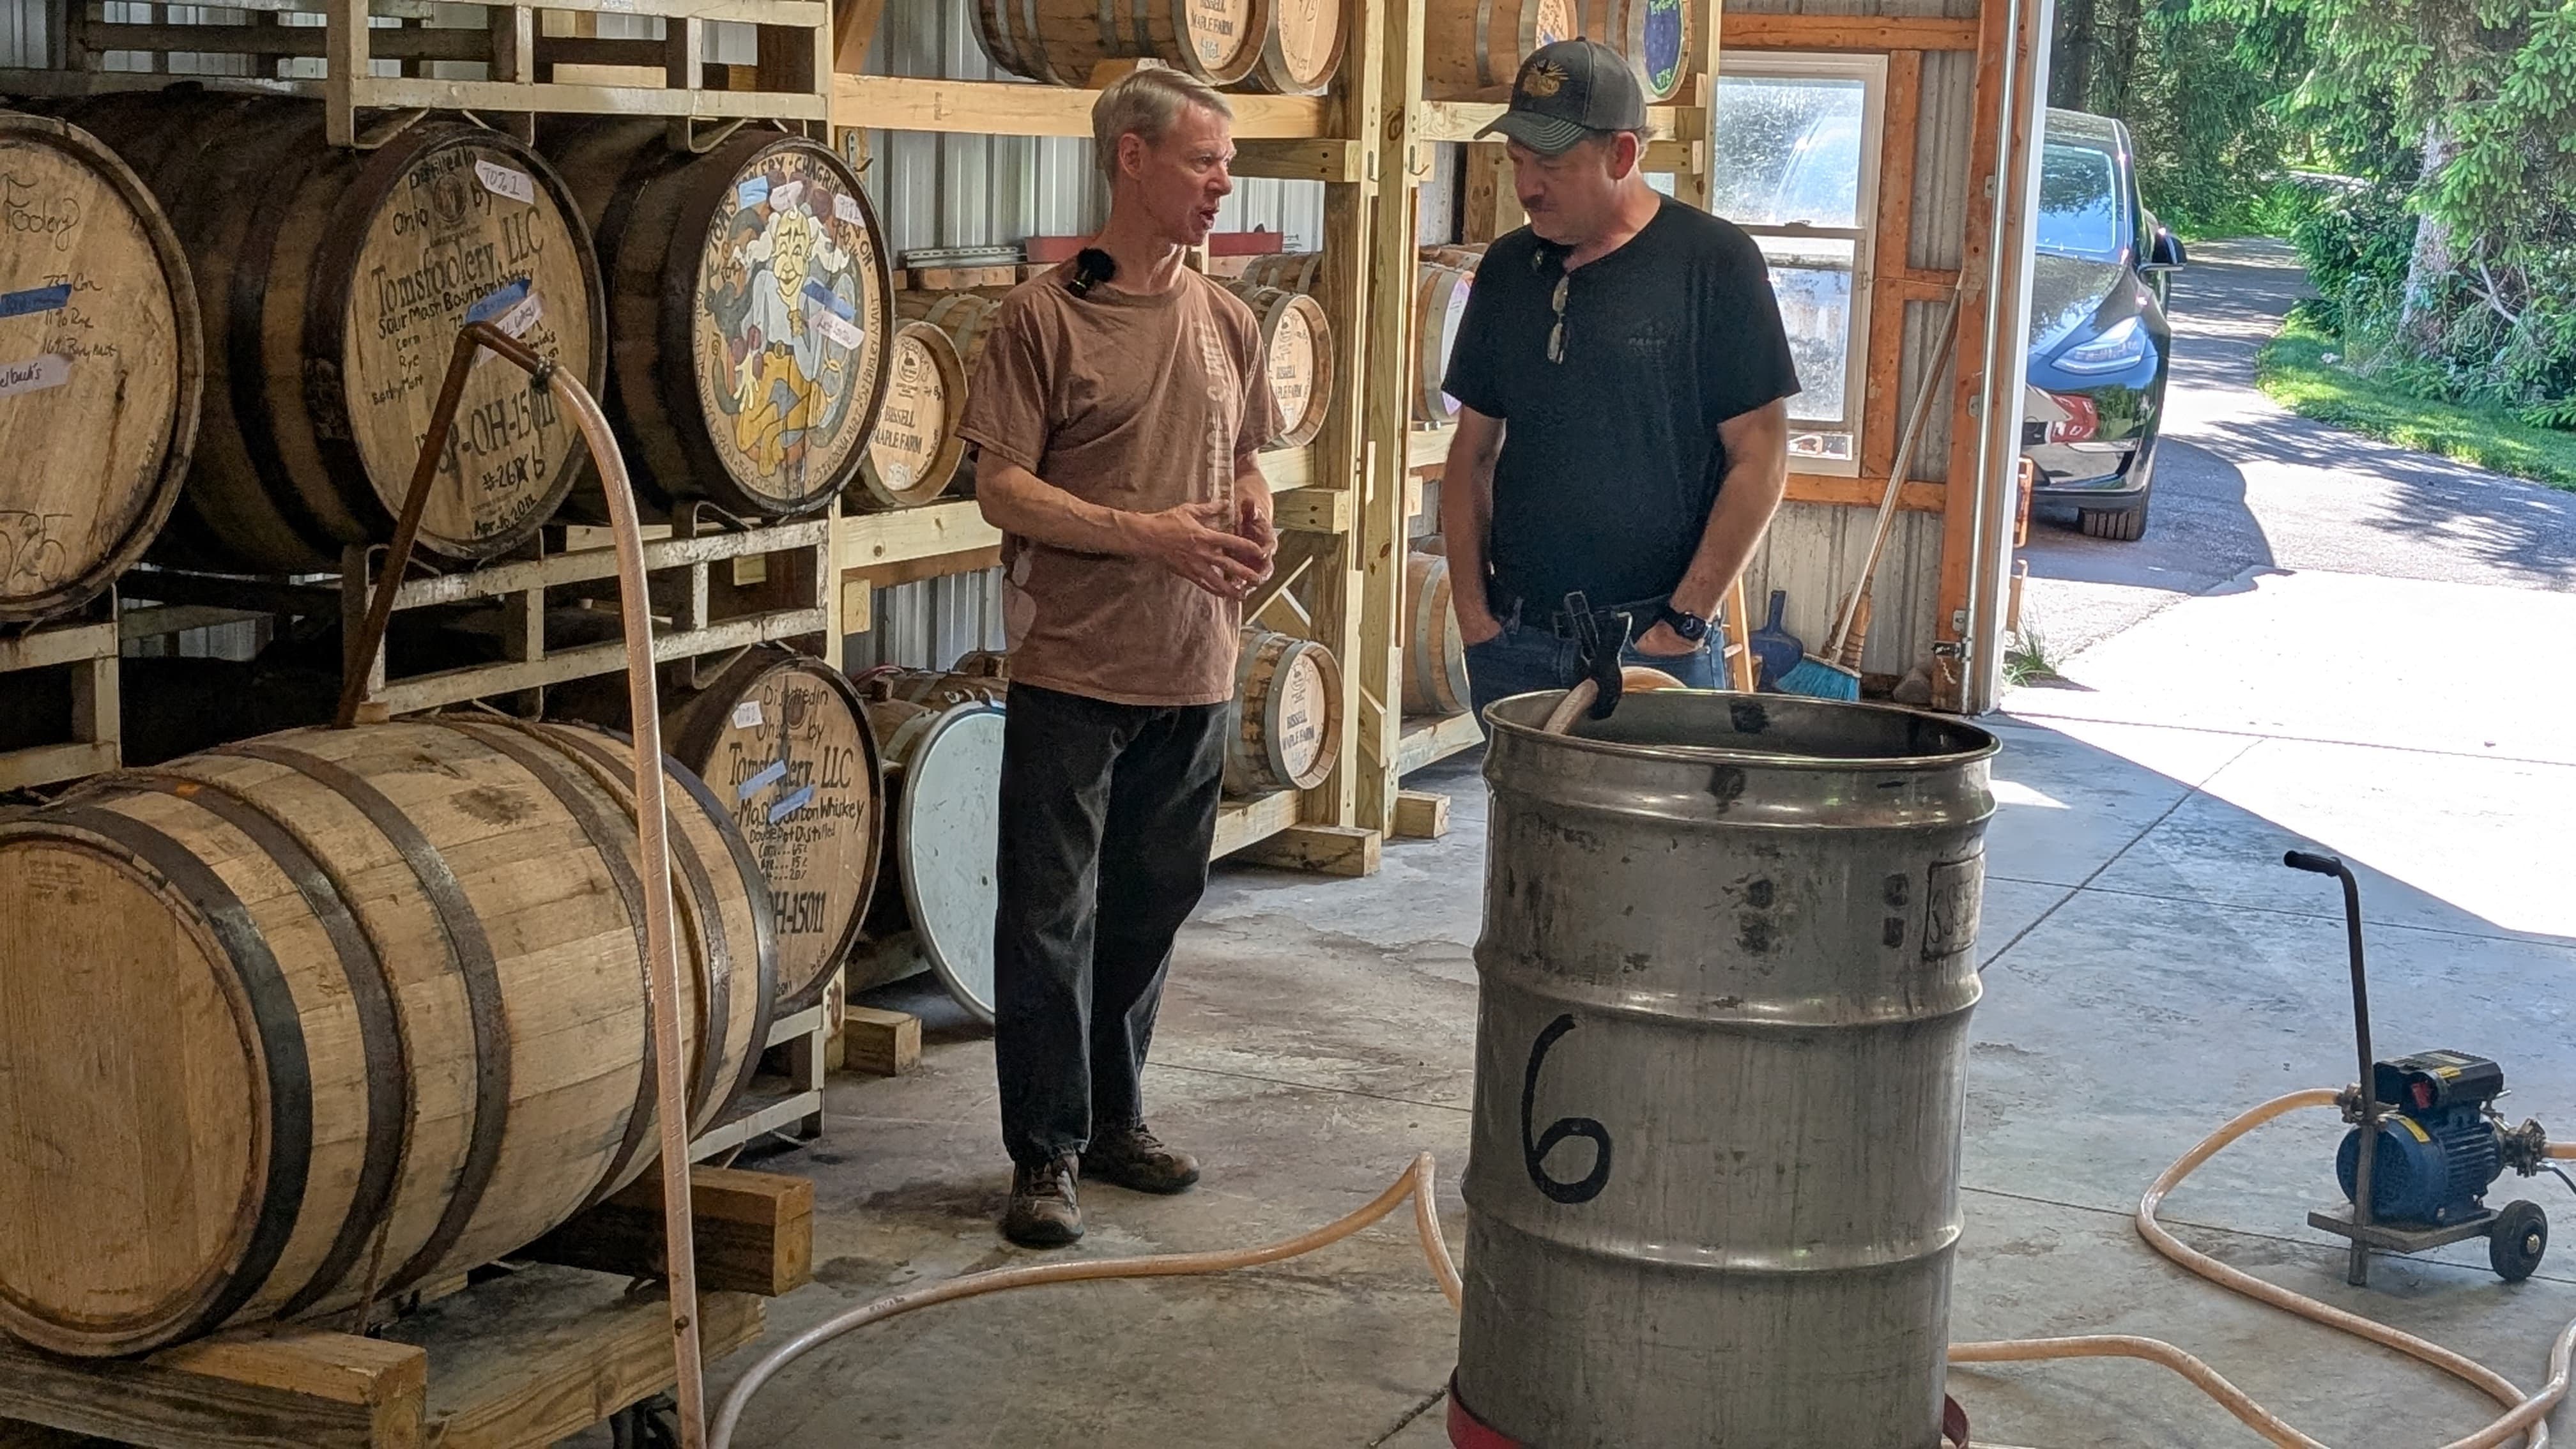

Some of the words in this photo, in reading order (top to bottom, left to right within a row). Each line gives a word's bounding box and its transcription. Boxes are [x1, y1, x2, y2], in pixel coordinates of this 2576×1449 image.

[392, 204, 429, 236] Ohio
[502, 205, 544, 266] LLC
[378, 309, 407, 340] Sour
[409, 300, 443, 325] Mash
[395, 333, 420, 352] Corn
[398, 354, 420, 372] Rye
[820, 745, 854, 789] LLC
[820, 796, 865, 833] Whiskey
[1521, 1013, 1612, 1204] 6
